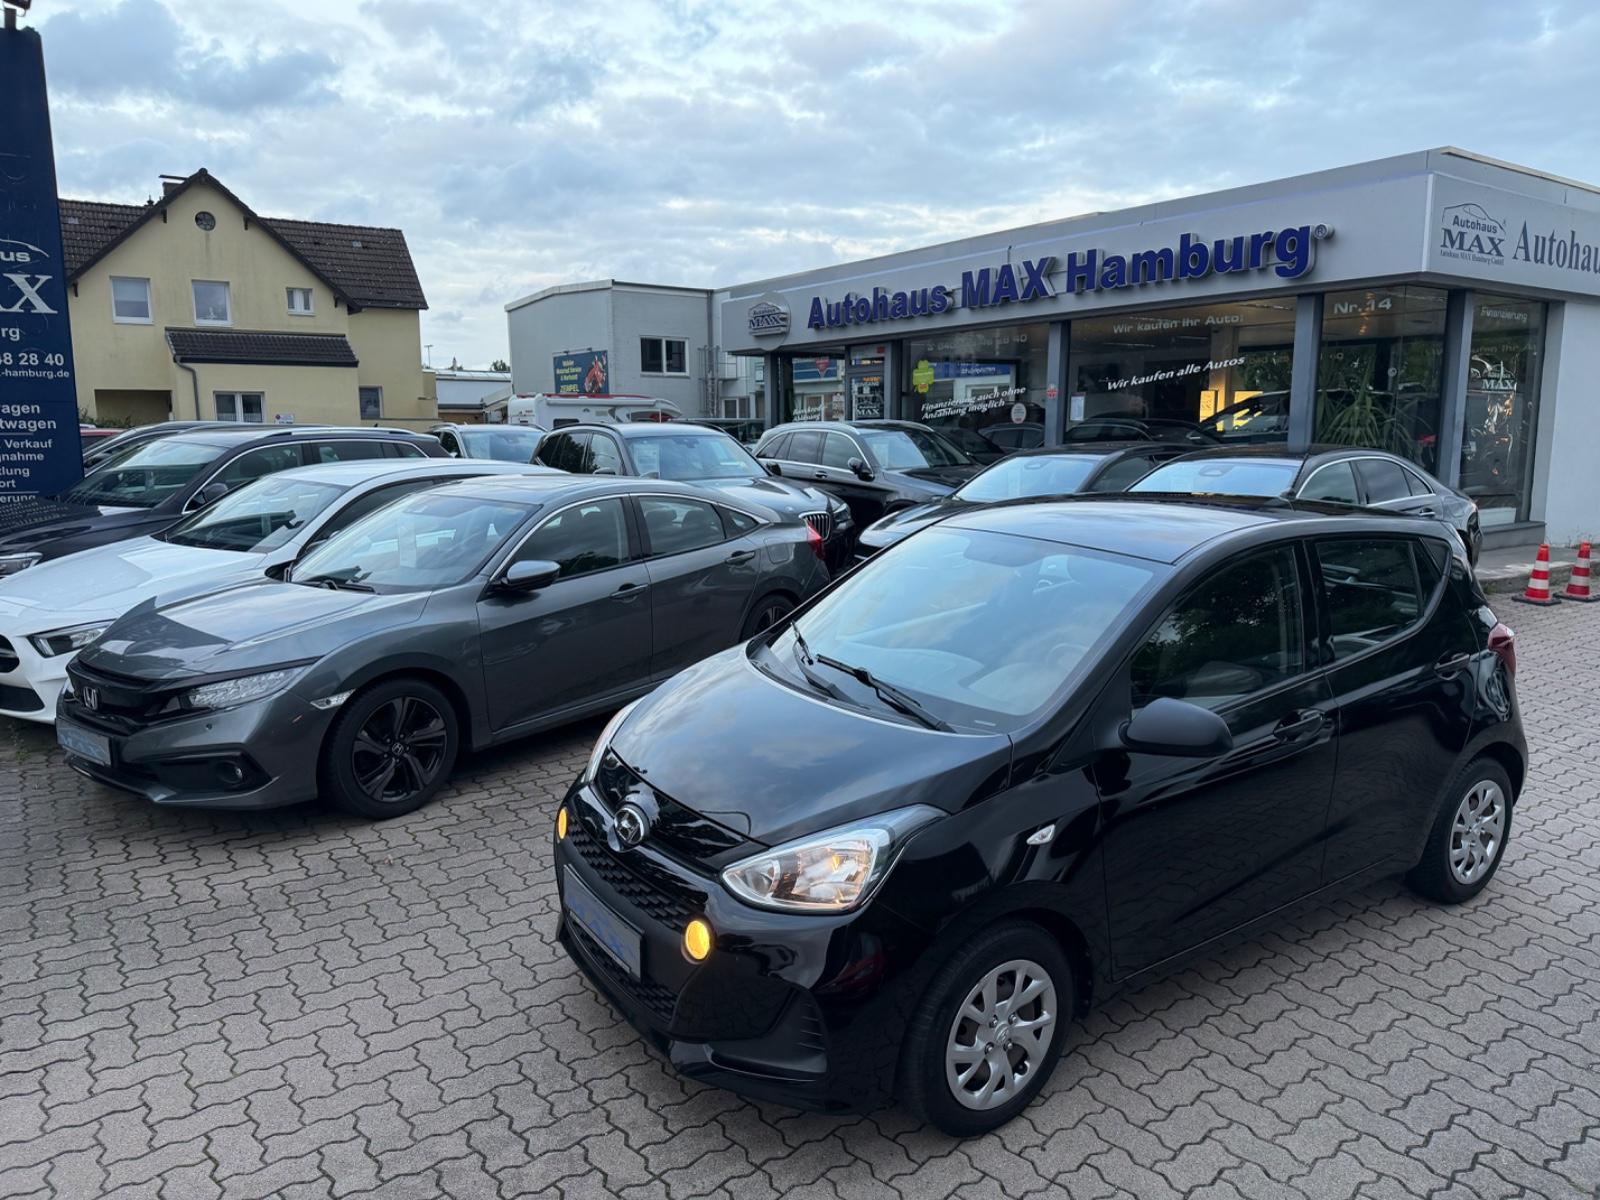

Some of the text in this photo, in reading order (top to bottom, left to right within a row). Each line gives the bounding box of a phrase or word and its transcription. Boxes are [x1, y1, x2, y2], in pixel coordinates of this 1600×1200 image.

[1452, 215, 1498, 234] Autohaus
[1440, 227, 1505, 258] MAX
[808, 285, 949, 329] Autohaus
[960, 256, 1053, 308] MAX
[750, 313, 785, 329] MAX
[1481, 306, 1528, 323] Finanzierung
[1113, 325, 1133, 334] Wir
[1137, 320, 1178, 332] kaufen
[19, 353, 39, 366] 28
[44, 353, 65, 366] 40
[1107, 356, 1246, 390] Wir kaufen alle Autos
[1482, 378, 1515, 390] MAX
[921, 386, 1027, 412] Finanzierung auch ohne
[857, 408, 880, 416] MAX
[921, 405, 967, 420] Anzahlung
[4, 438, 53, 449] Verkauf
